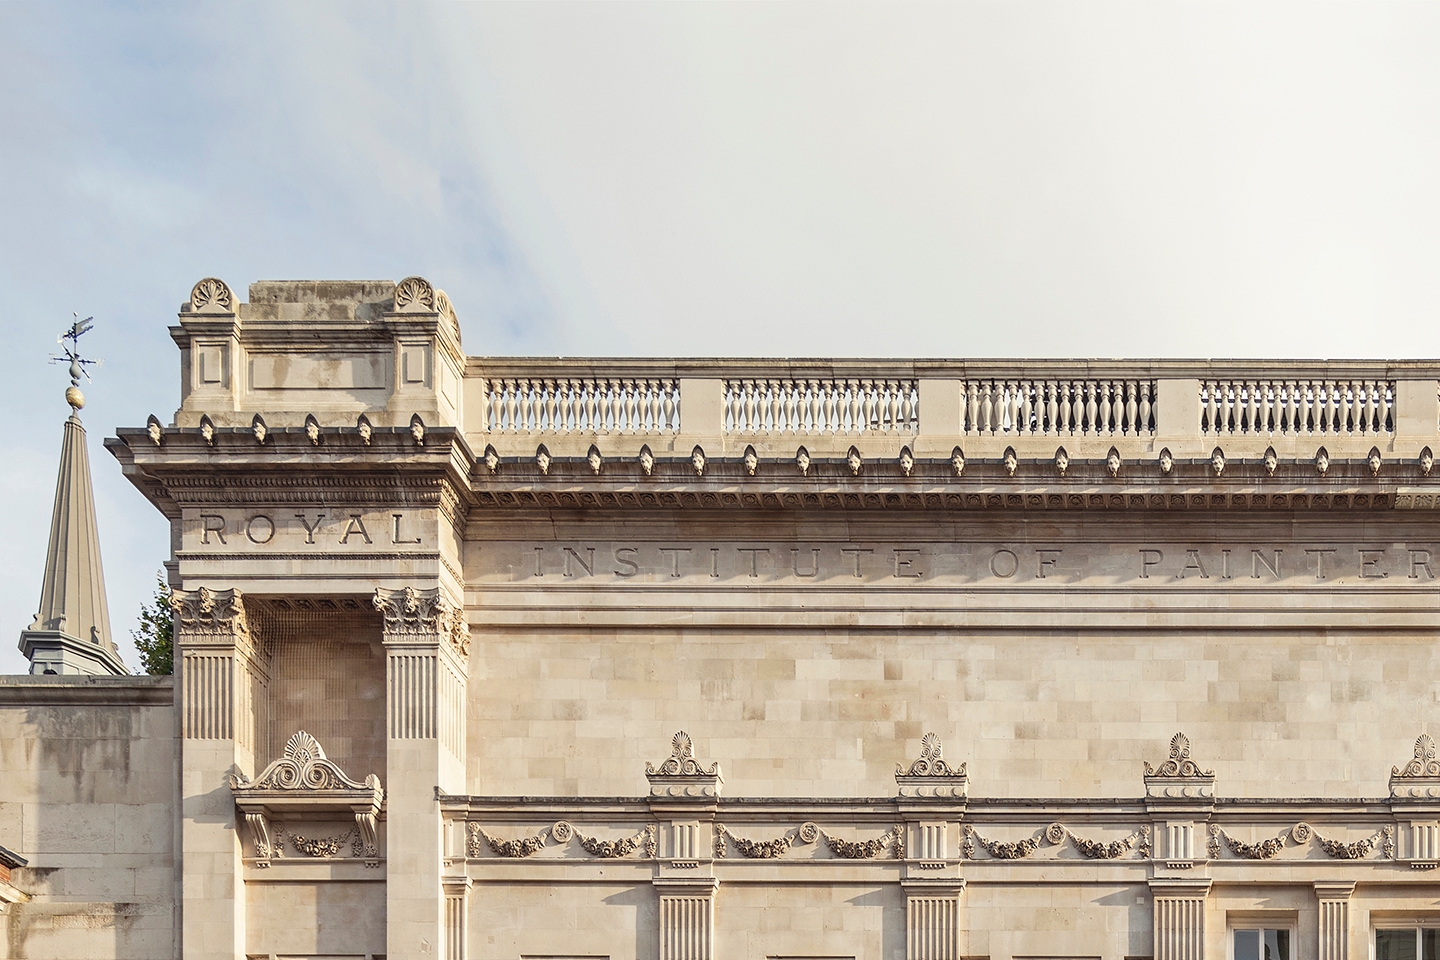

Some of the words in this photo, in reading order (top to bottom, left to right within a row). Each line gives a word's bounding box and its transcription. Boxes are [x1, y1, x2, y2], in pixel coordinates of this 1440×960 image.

[199, 513, 422, 545] ROYAL
[533, 546, 923, 579] INSTITUTE
[989, 547, 1064, 579] OF
